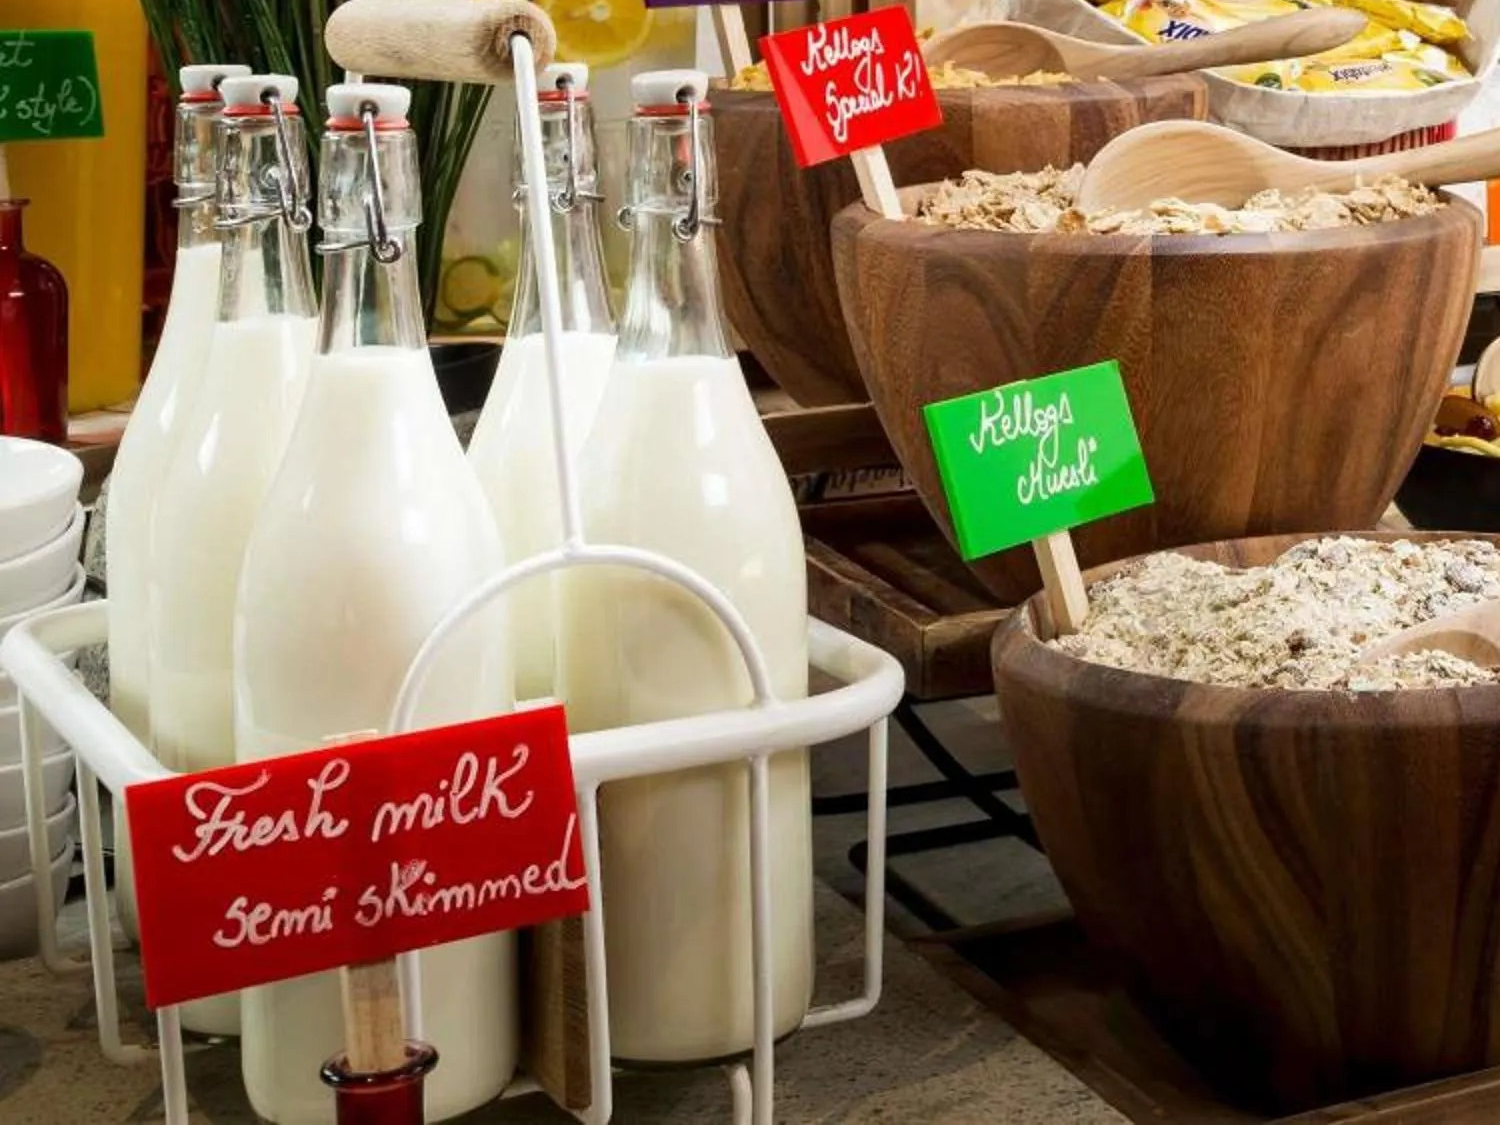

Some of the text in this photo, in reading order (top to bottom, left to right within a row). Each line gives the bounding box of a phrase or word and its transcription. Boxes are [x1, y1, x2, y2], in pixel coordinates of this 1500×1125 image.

[801, 25, 885, 92] Kellogs
[969, 386, 1074, 468] Kellogs
[172, 743, 534, 862] Fresh milk
[213, 813, 588, 948] semi skimmed
